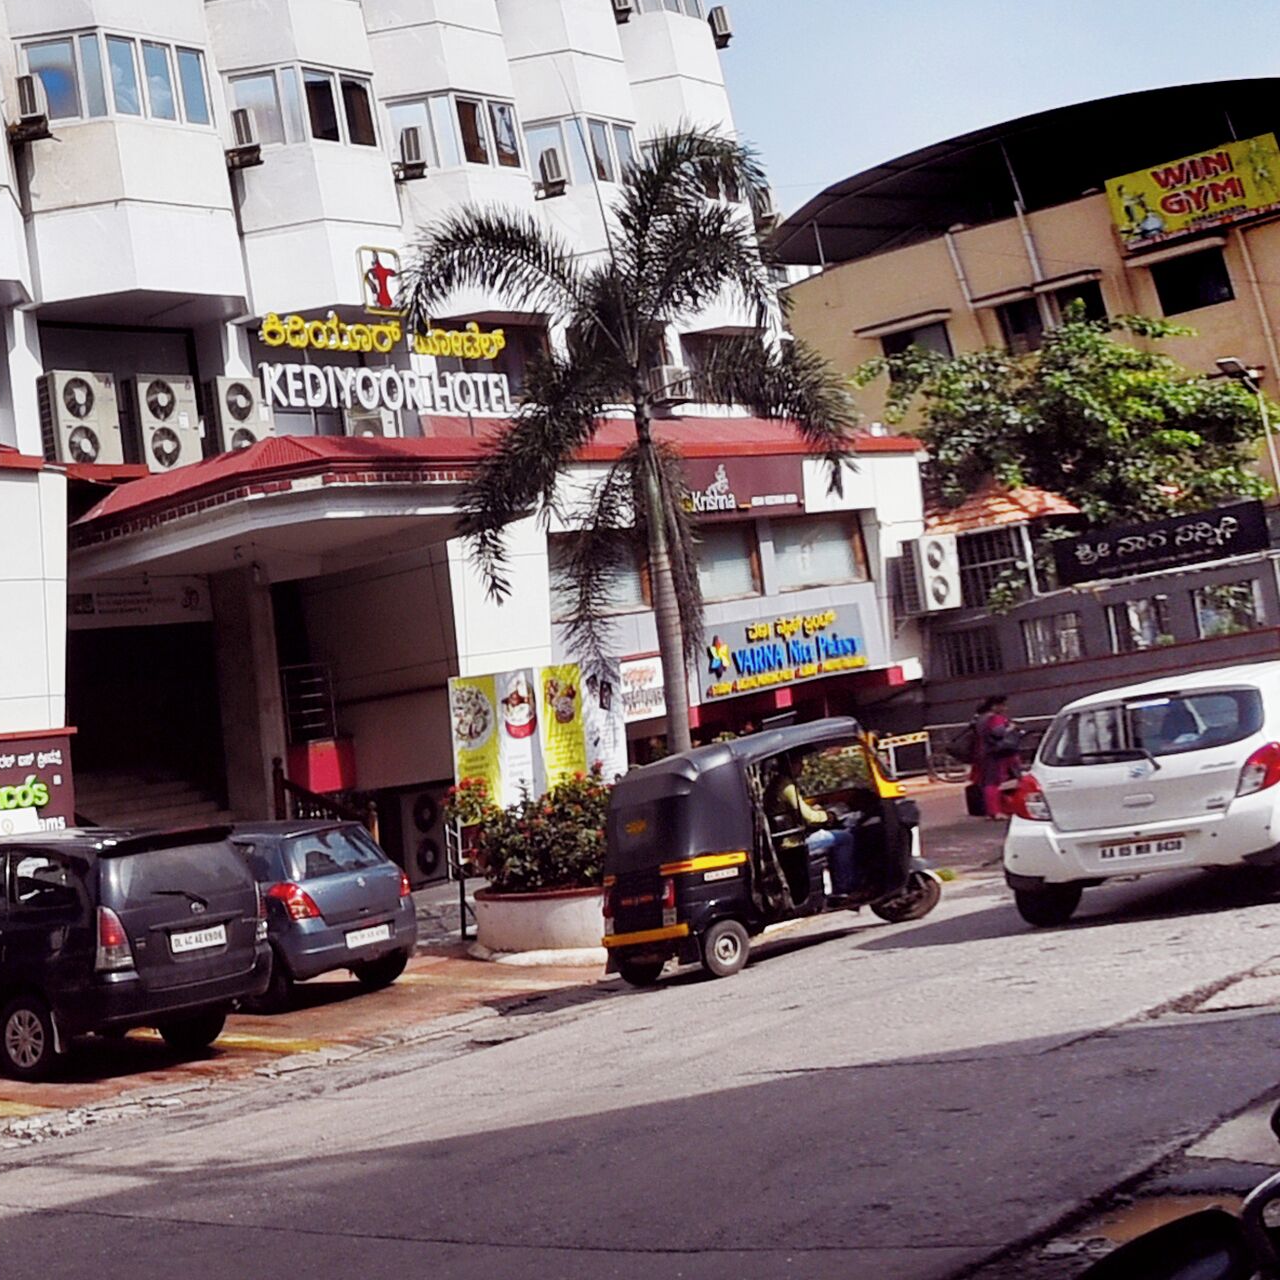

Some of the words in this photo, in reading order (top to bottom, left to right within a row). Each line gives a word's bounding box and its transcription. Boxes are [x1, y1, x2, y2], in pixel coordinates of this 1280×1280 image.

[1150, 151, 1234, 189] WIN
[1160, 177, 1246, 214] GYM
[259, 362, 425, 412] KEDIYOOR
[431, 372, 517, 414] HOTEL
[733, 642, 784, 676] VARNA
